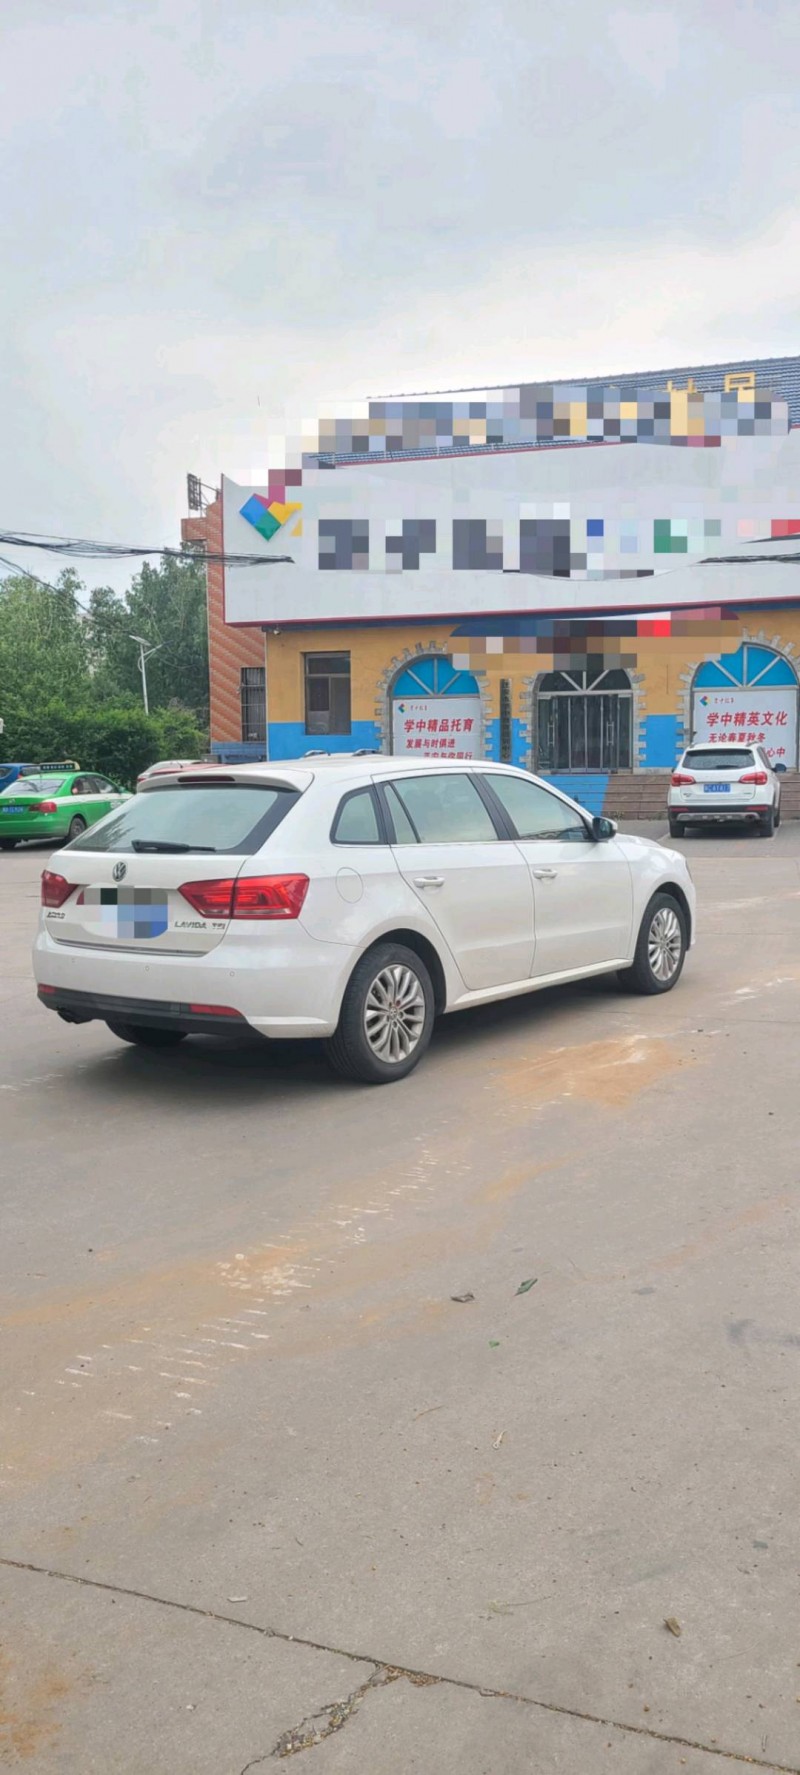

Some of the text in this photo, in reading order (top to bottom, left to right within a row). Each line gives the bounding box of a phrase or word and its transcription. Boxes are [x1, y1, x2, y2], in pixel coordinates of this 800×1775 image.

[706, 711, 788, 727] 学中精英文化
[404, 718, 474, 733] 学中精品托育
[708, 732, 766, 743] 无论春夏秋冬
[406, 738, 456, 749] 发展与时俱进
[763, 747, 786, 758] 心中
[174, 921, 207, 930] LAVIDA
